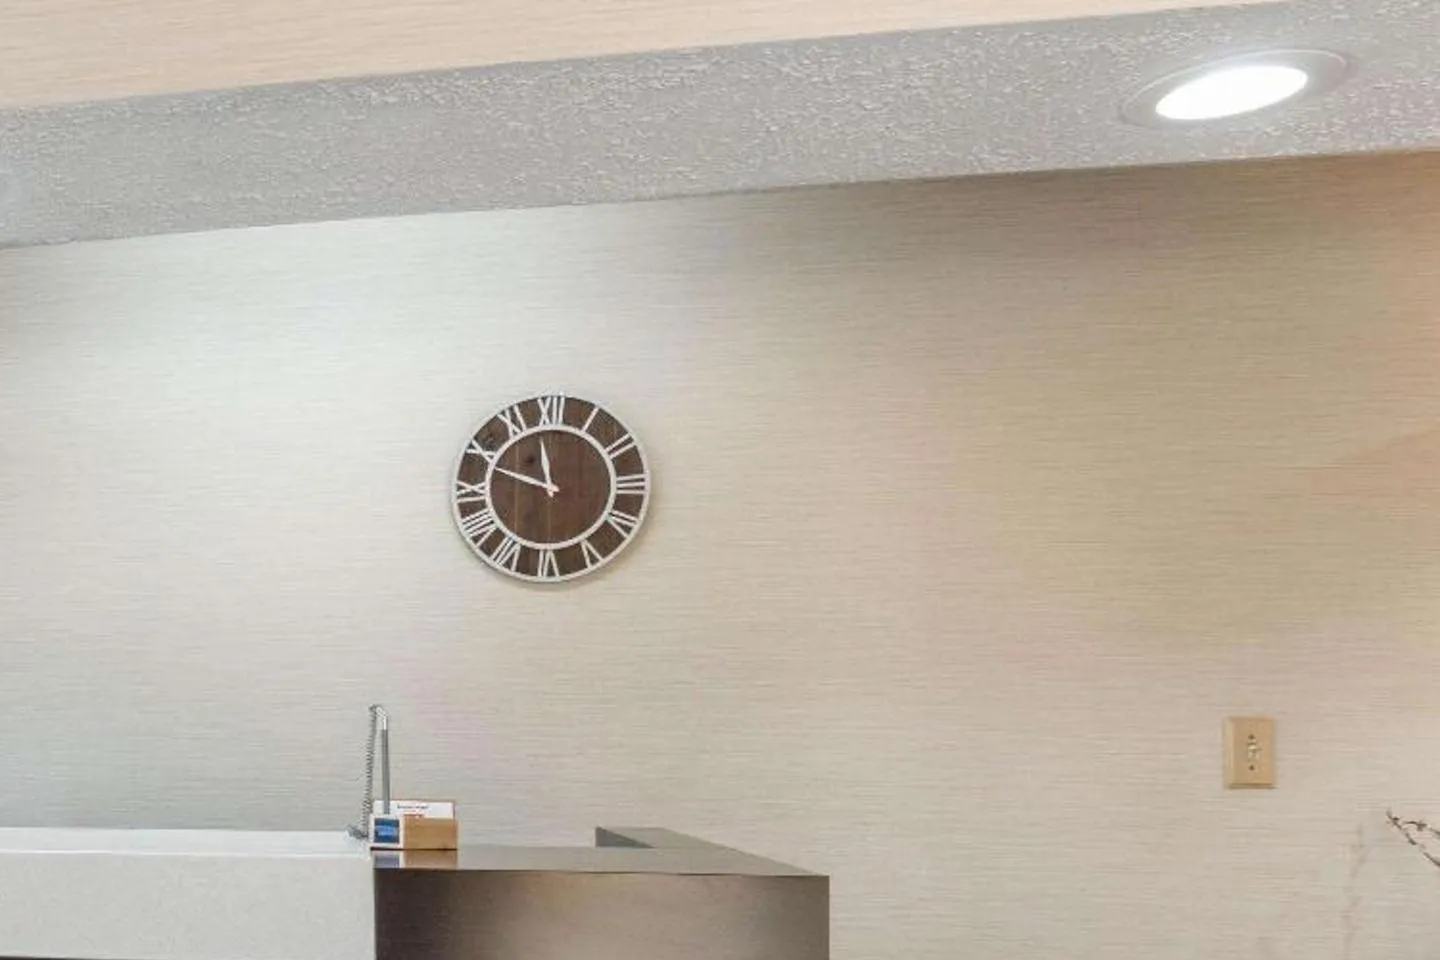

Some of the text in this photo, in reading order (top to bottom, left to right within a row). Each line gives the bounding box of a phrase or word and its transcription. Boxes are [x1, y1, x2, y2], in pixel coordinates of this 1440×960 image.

[497, 404, 527, 438] XI
[537, 396, 566, 427] XII
[467, 440, 495, 464] X
[604, 433, 637, 460] II
[456, 481, 487, 503] IX
[615, 475, 647, 494] III
[461, 509, 497, 547] VIII
[607, 510, 638, 539] IV
[491, 538, 521, 572] VII
[538, 549, 560, 577] VI
[581, 540, 604, 569] V
